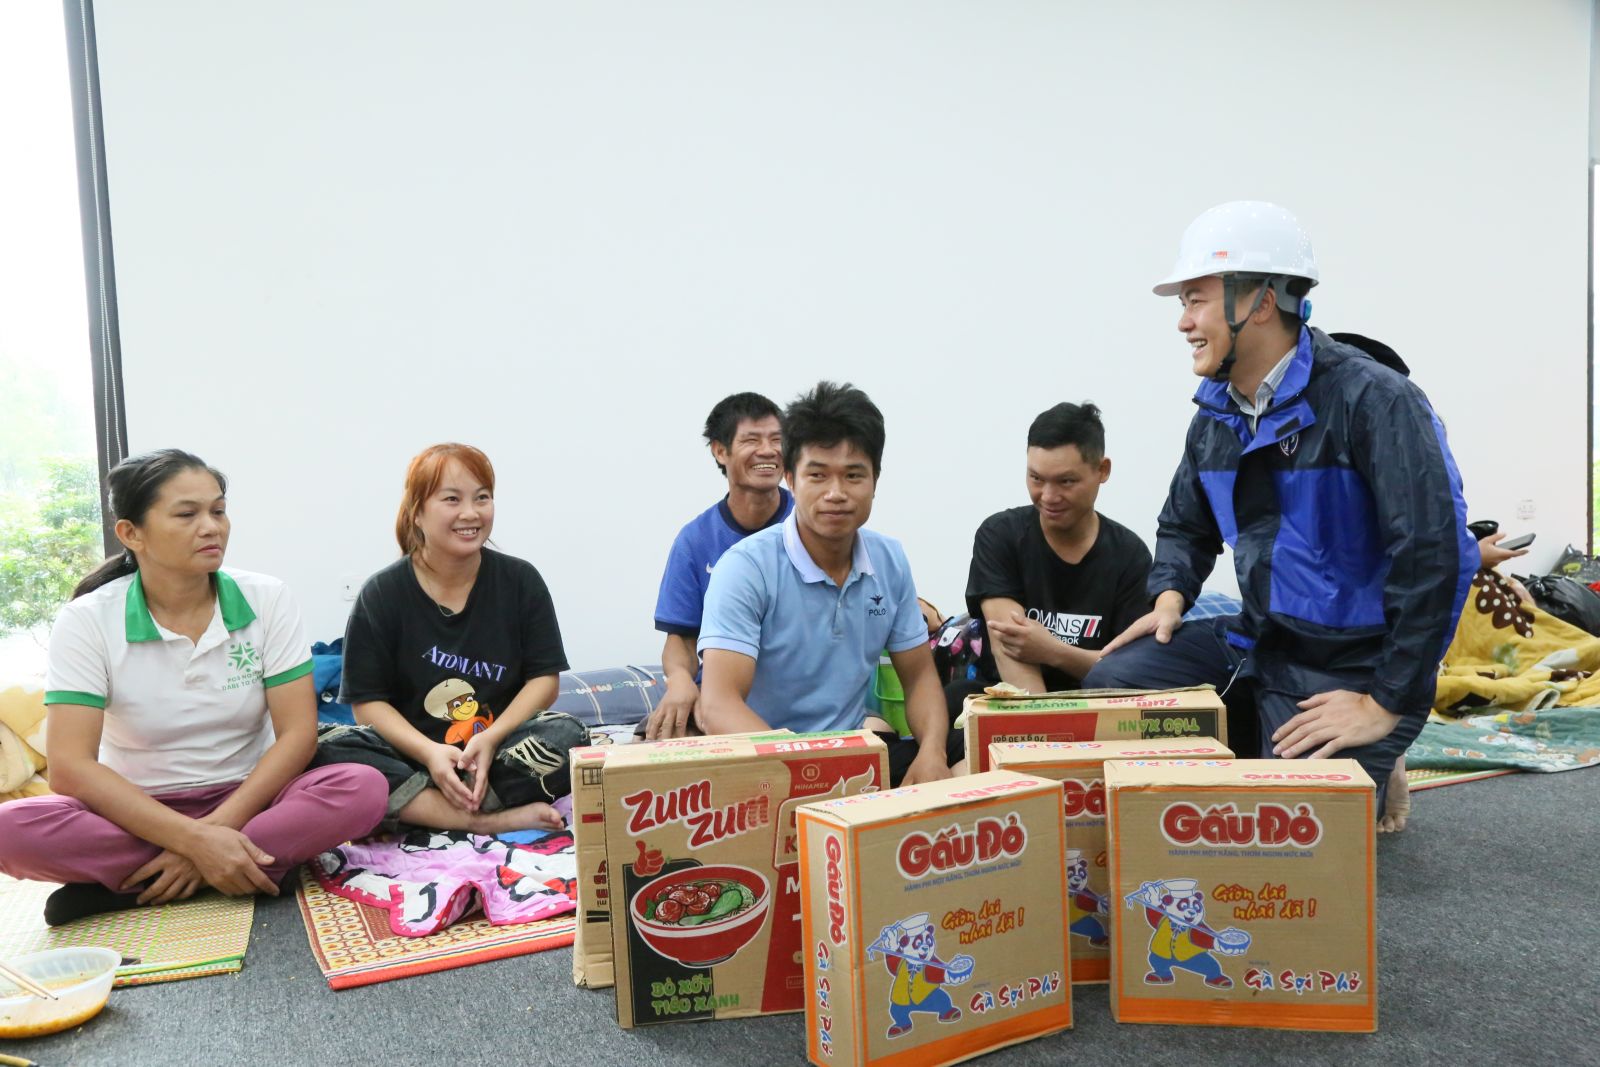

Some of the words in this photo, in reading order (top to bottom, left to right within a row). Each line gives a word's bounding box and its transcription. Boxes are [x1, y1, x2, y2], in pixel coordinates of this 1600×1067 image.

[868, 608, 887, 617] POLO
[623, 779, 712, 834] Zum
[685, 794, 769, 848] Zum
[817, 941, 832, 970] Gà
[651, 977, 676, 998] BÒ
[678, 973, 712, 995] XỐT
[817, 977, 832, 1011] Sợi
[970, 991, 995, 1013] Gà
[998, 984, 1024, 1008] Sợi
[1027, 971, 1061, 999] Phở
[1243, 968, 1275, 992] Gà
[1280, 969, 1314, 996] Sợi
[1318, 969, 1362, 993] Phở
[651, 995, 691, 1015] TIÊU
[694, 993, 740, 1012] XANH
[819, 1016, 833, 1057] Phở
